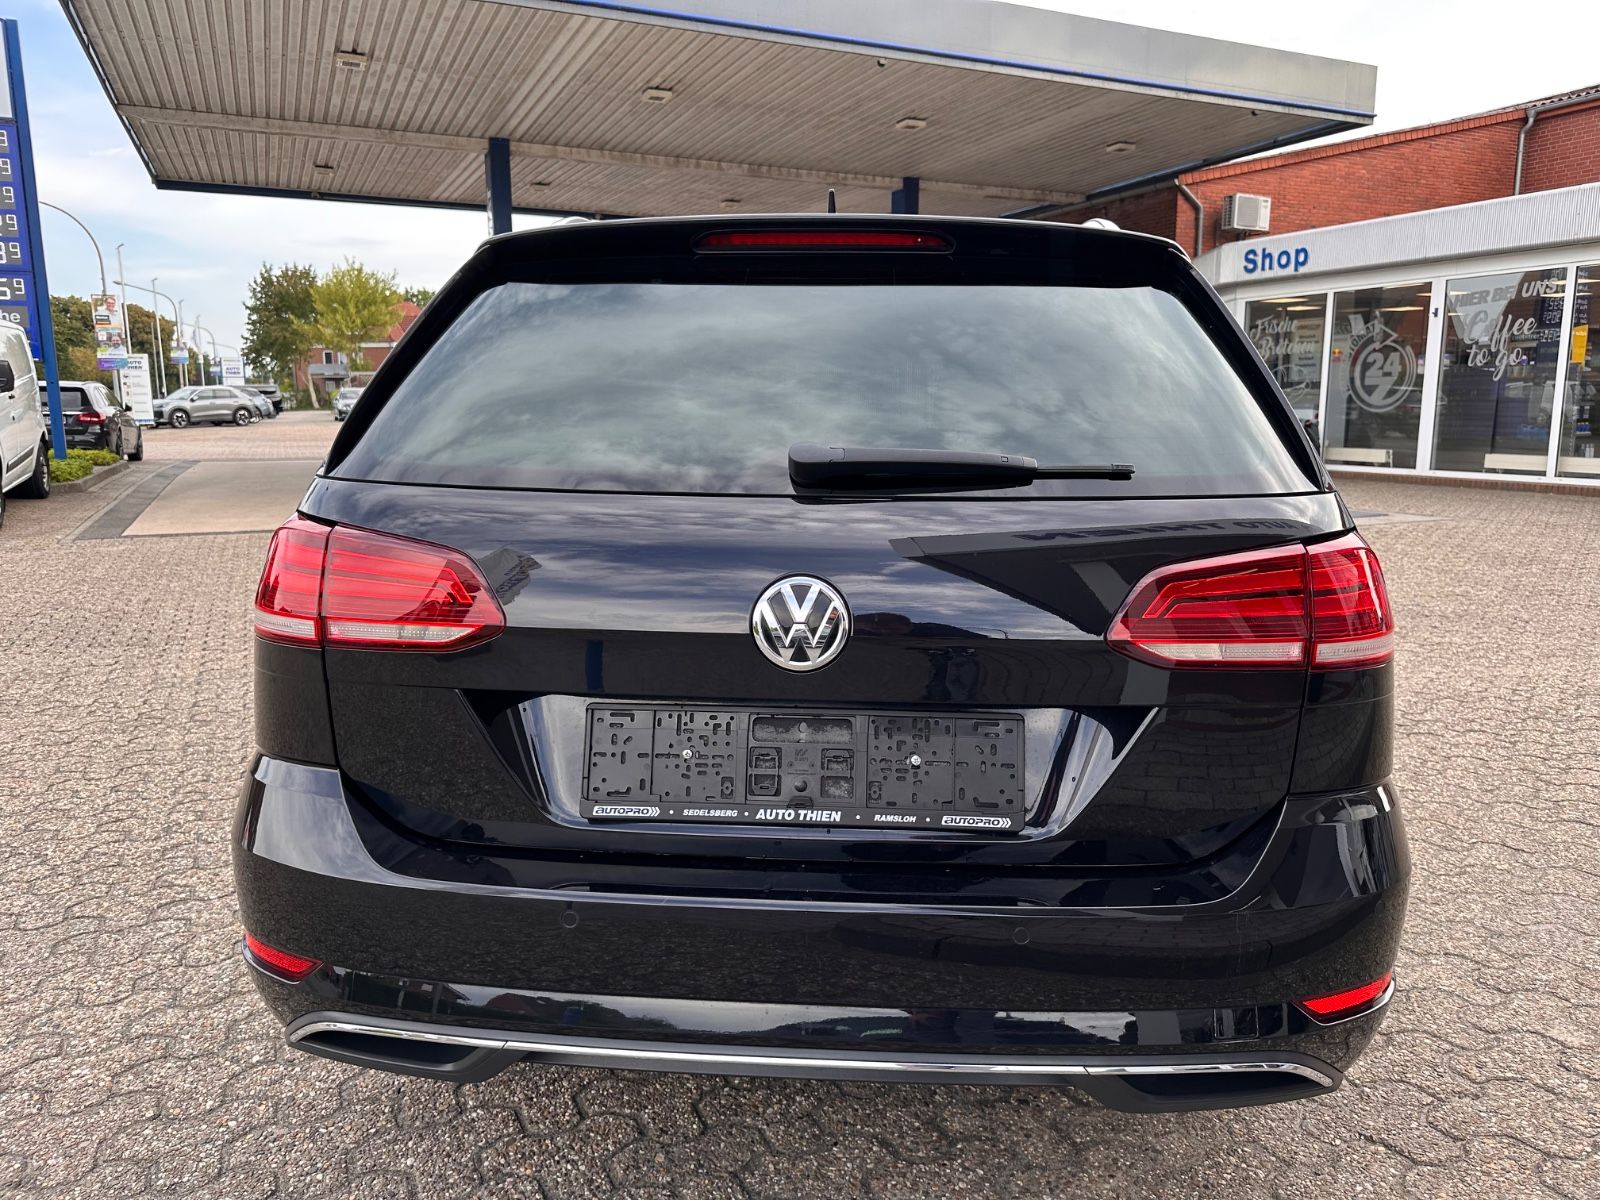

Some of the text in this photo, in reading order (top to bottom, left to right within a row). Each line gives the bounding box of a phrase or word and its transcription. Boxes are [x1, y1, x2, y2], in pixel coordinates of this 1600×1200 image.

[1243, 247, 1309, 274] Shop
[1521, 278, 1558, 298] UNS
[1249, 315, 1299, 341] Frische
[1463, 310, 1538, 353] Coffee
[1364, 351, 1402, 378] 24
[1466, 344, 1523, 381] to go
[682, 808, 738, 818] SEDELSBERG
[755, 809, 795, 821] AUTO
[797, 809, 842, 822] THIEN
[873, 814, 917, 823] RAMSLOH
